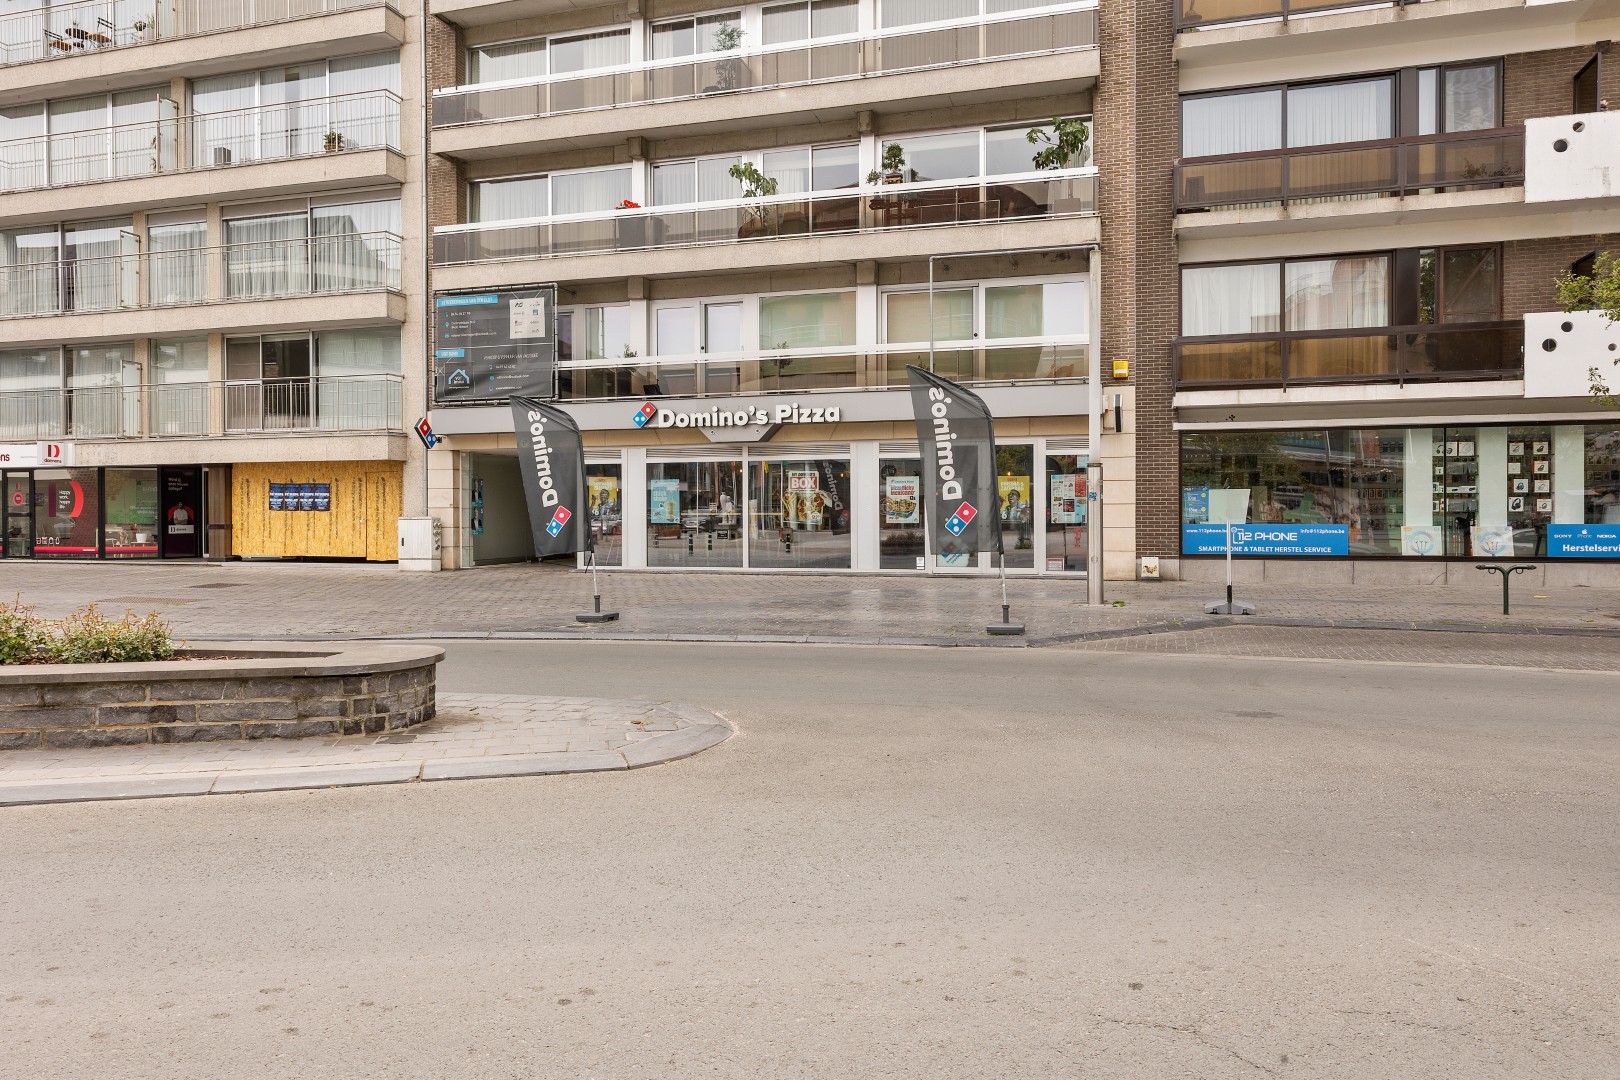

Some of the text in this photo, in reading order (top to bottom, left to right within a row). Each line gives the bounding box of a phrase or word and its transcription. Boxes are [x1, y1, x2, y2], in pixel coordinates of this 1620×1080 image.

[658, 403, 840, 429] Domino's Pizza
[791, 478, 815, 488] BOX
[1237, 532, 1298, 541] 112 PHONE
